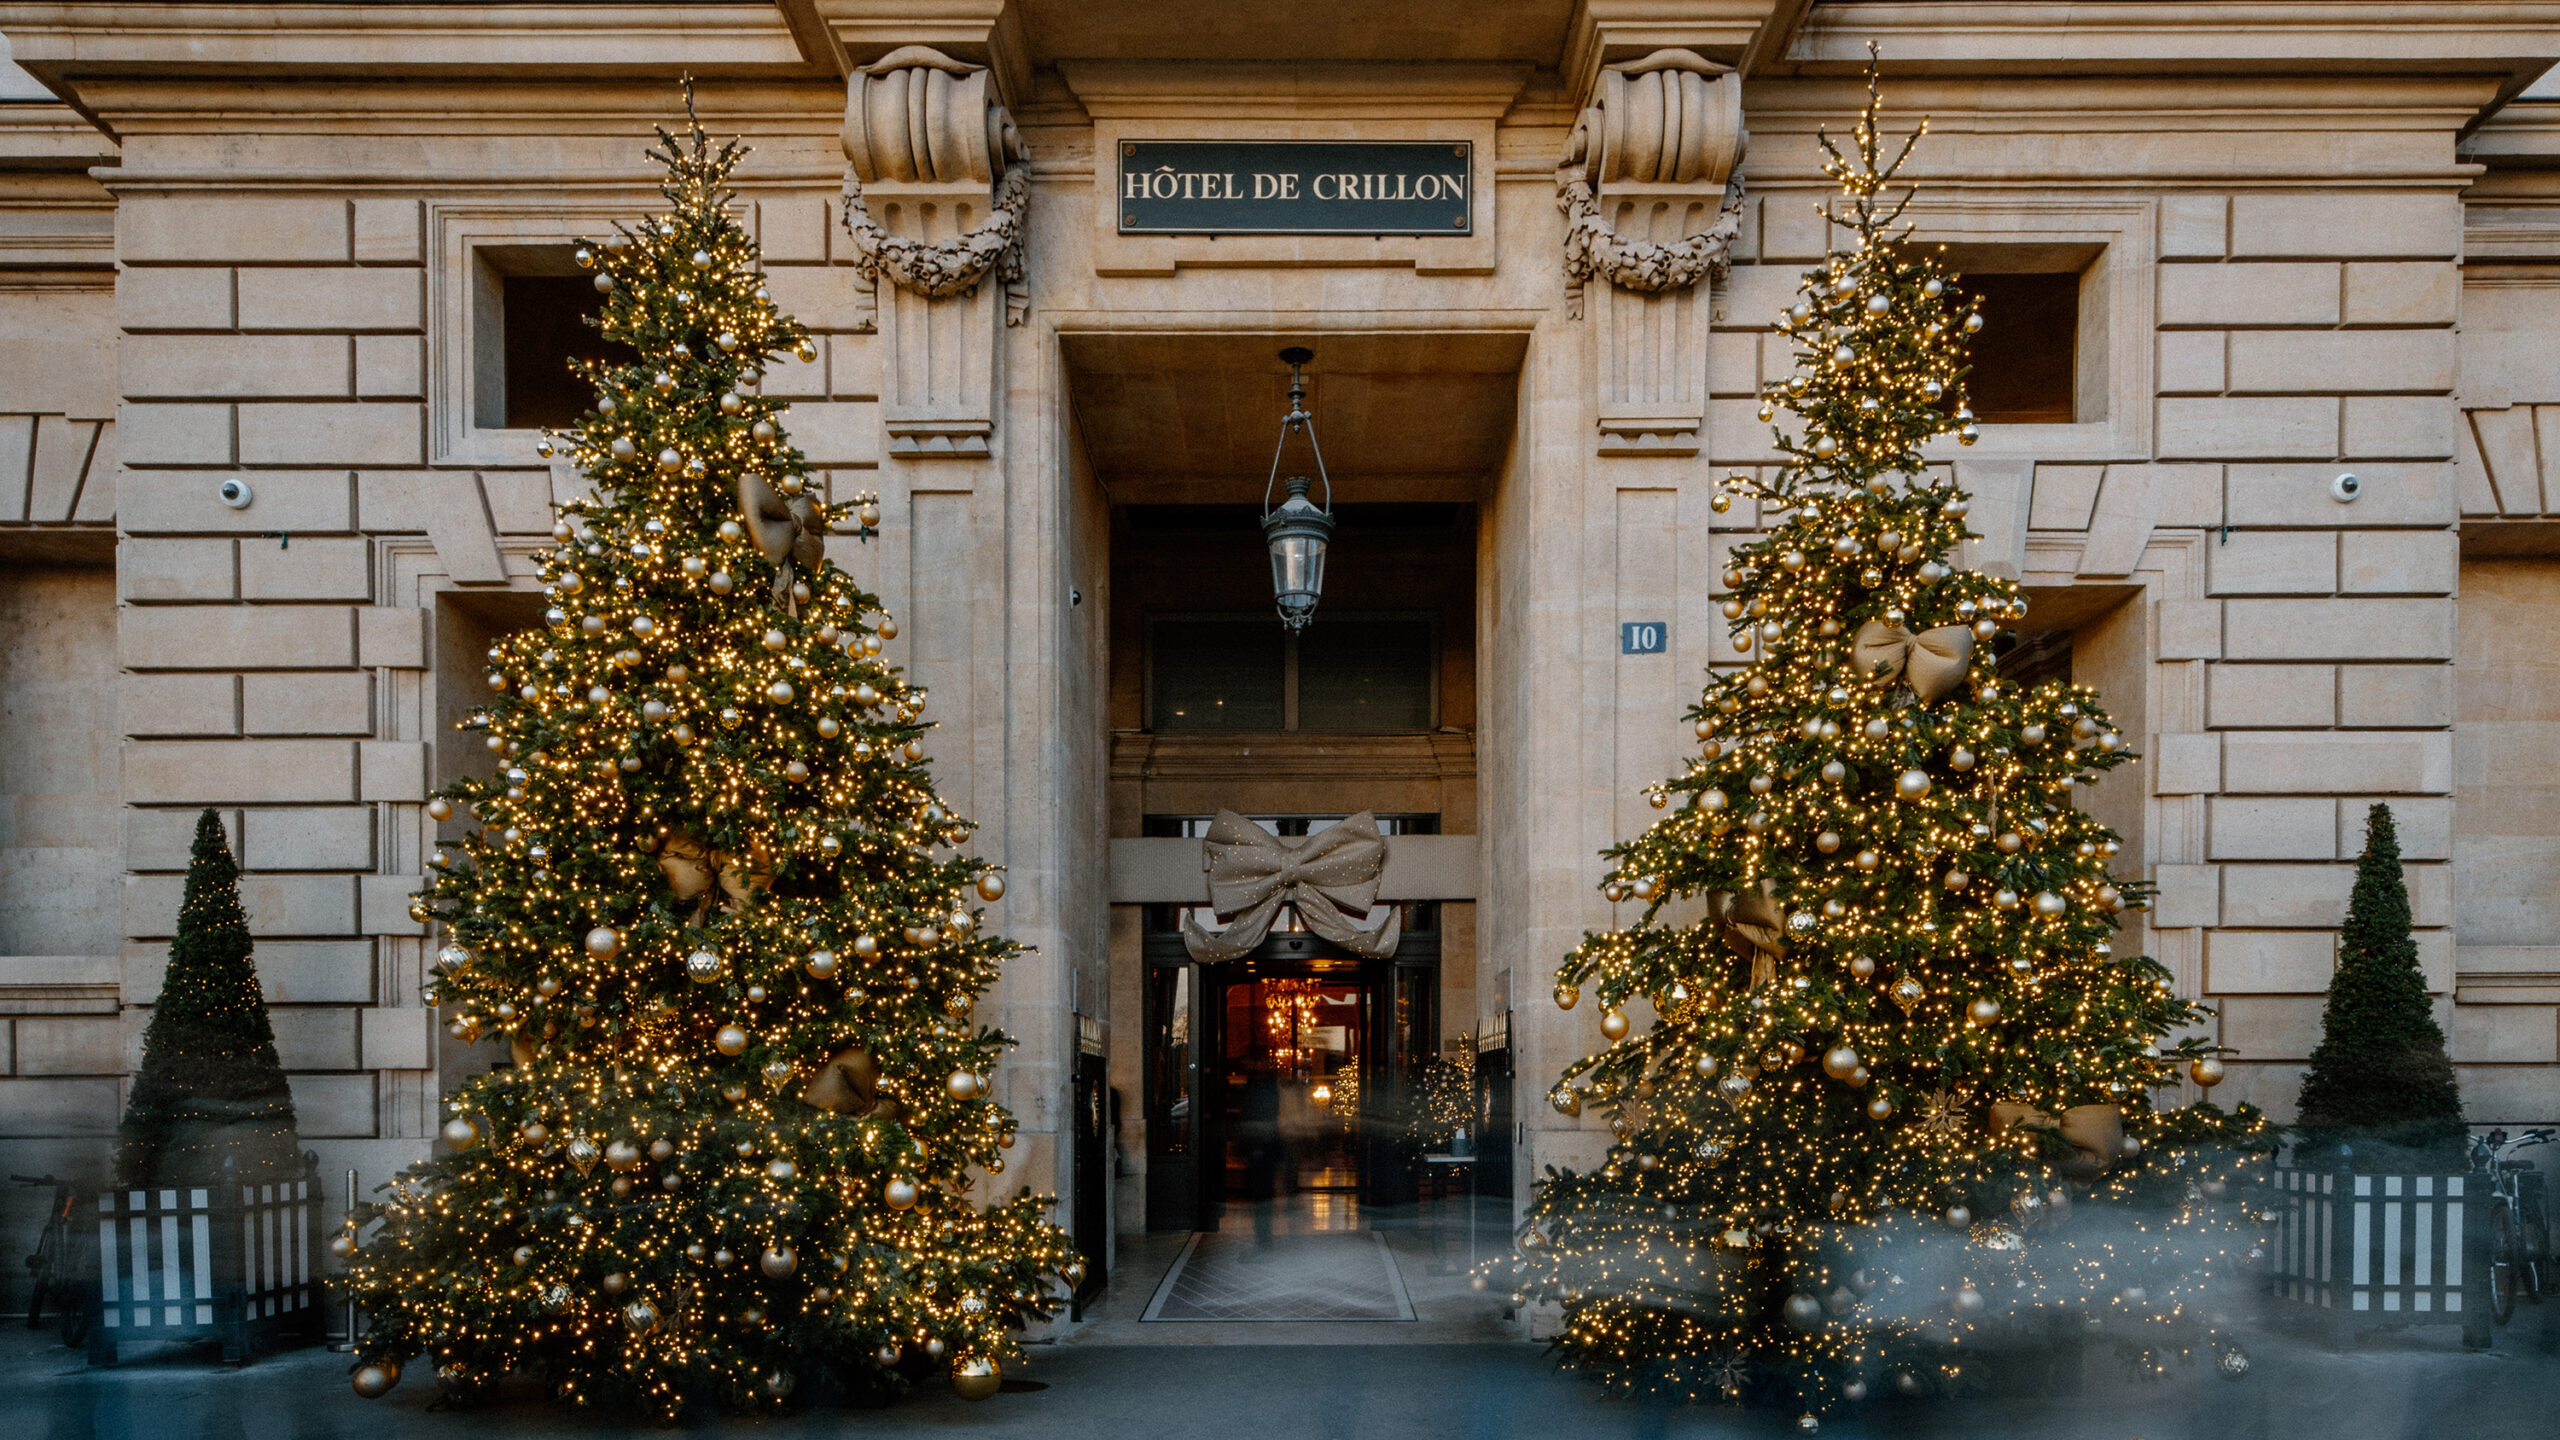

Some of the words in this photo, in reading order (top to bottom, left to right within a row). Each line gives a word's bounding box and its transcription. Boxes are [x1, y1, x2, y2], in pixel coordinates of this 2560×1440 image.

[1124, 165, 1244, 199] HÔTEL
[1253, 173, 1300, 200] DE
[1313, 174, 1465, 200] CRILLON
[1631, 626, 1657, 650] 10
